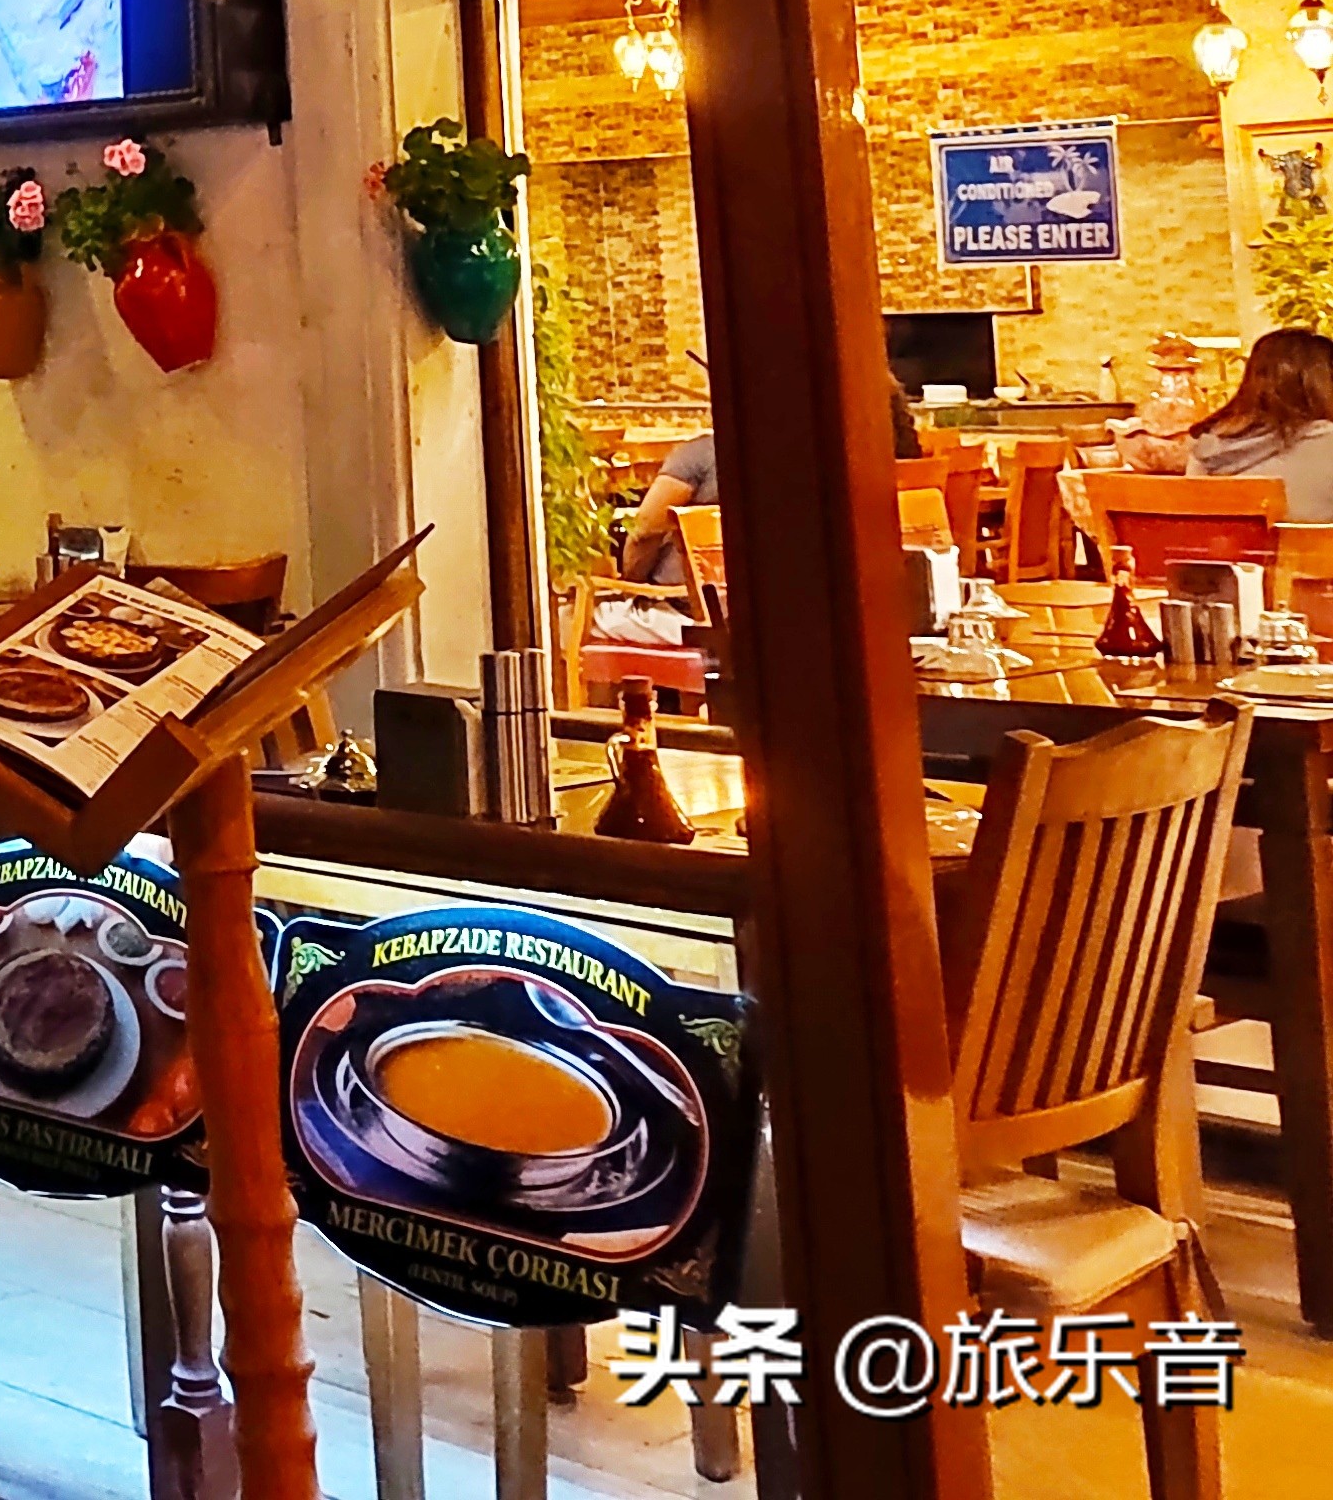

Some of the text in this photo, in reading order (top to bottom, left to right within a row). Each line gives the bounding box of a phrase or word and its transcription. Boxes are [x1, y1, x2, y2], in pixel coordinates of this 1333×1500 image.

[957, 180, 1055, 201] CONDITIONED
[953, 222, 1111, 252] PLEASE ENTER
[371, 927, 652, 1018] KEBAPZADE RESTAURANT
[14, 1116, 155, 1176] PASTIRMALI
[485, 1242, 622, 1304] ÇORBASI
